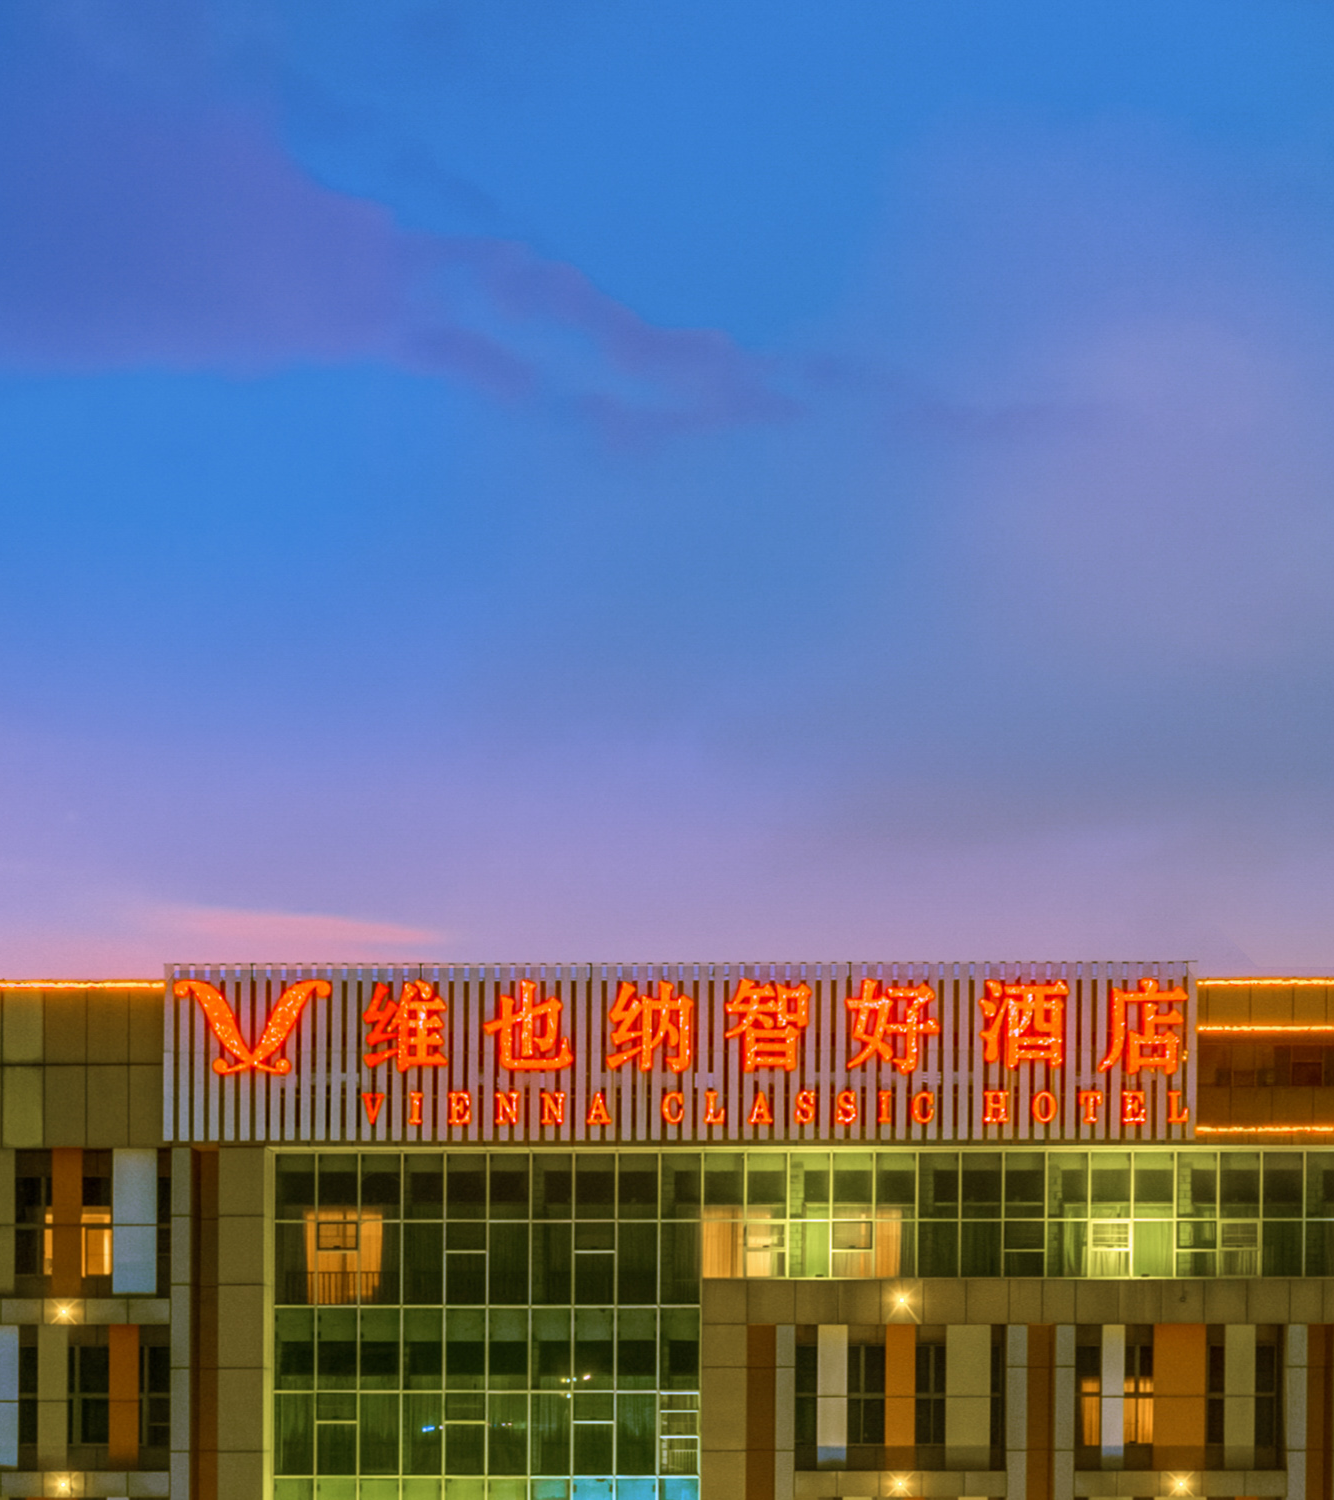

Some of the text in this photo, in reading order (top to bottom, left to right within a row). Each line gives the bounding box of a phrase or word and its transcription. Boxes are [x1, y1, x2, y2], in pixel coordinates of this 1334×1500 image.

[362, 977, 1189, 1076] 维也纳智好酒店
[362, 1090, 1189, 1126] VIENNA CLASSIC HOTEL
